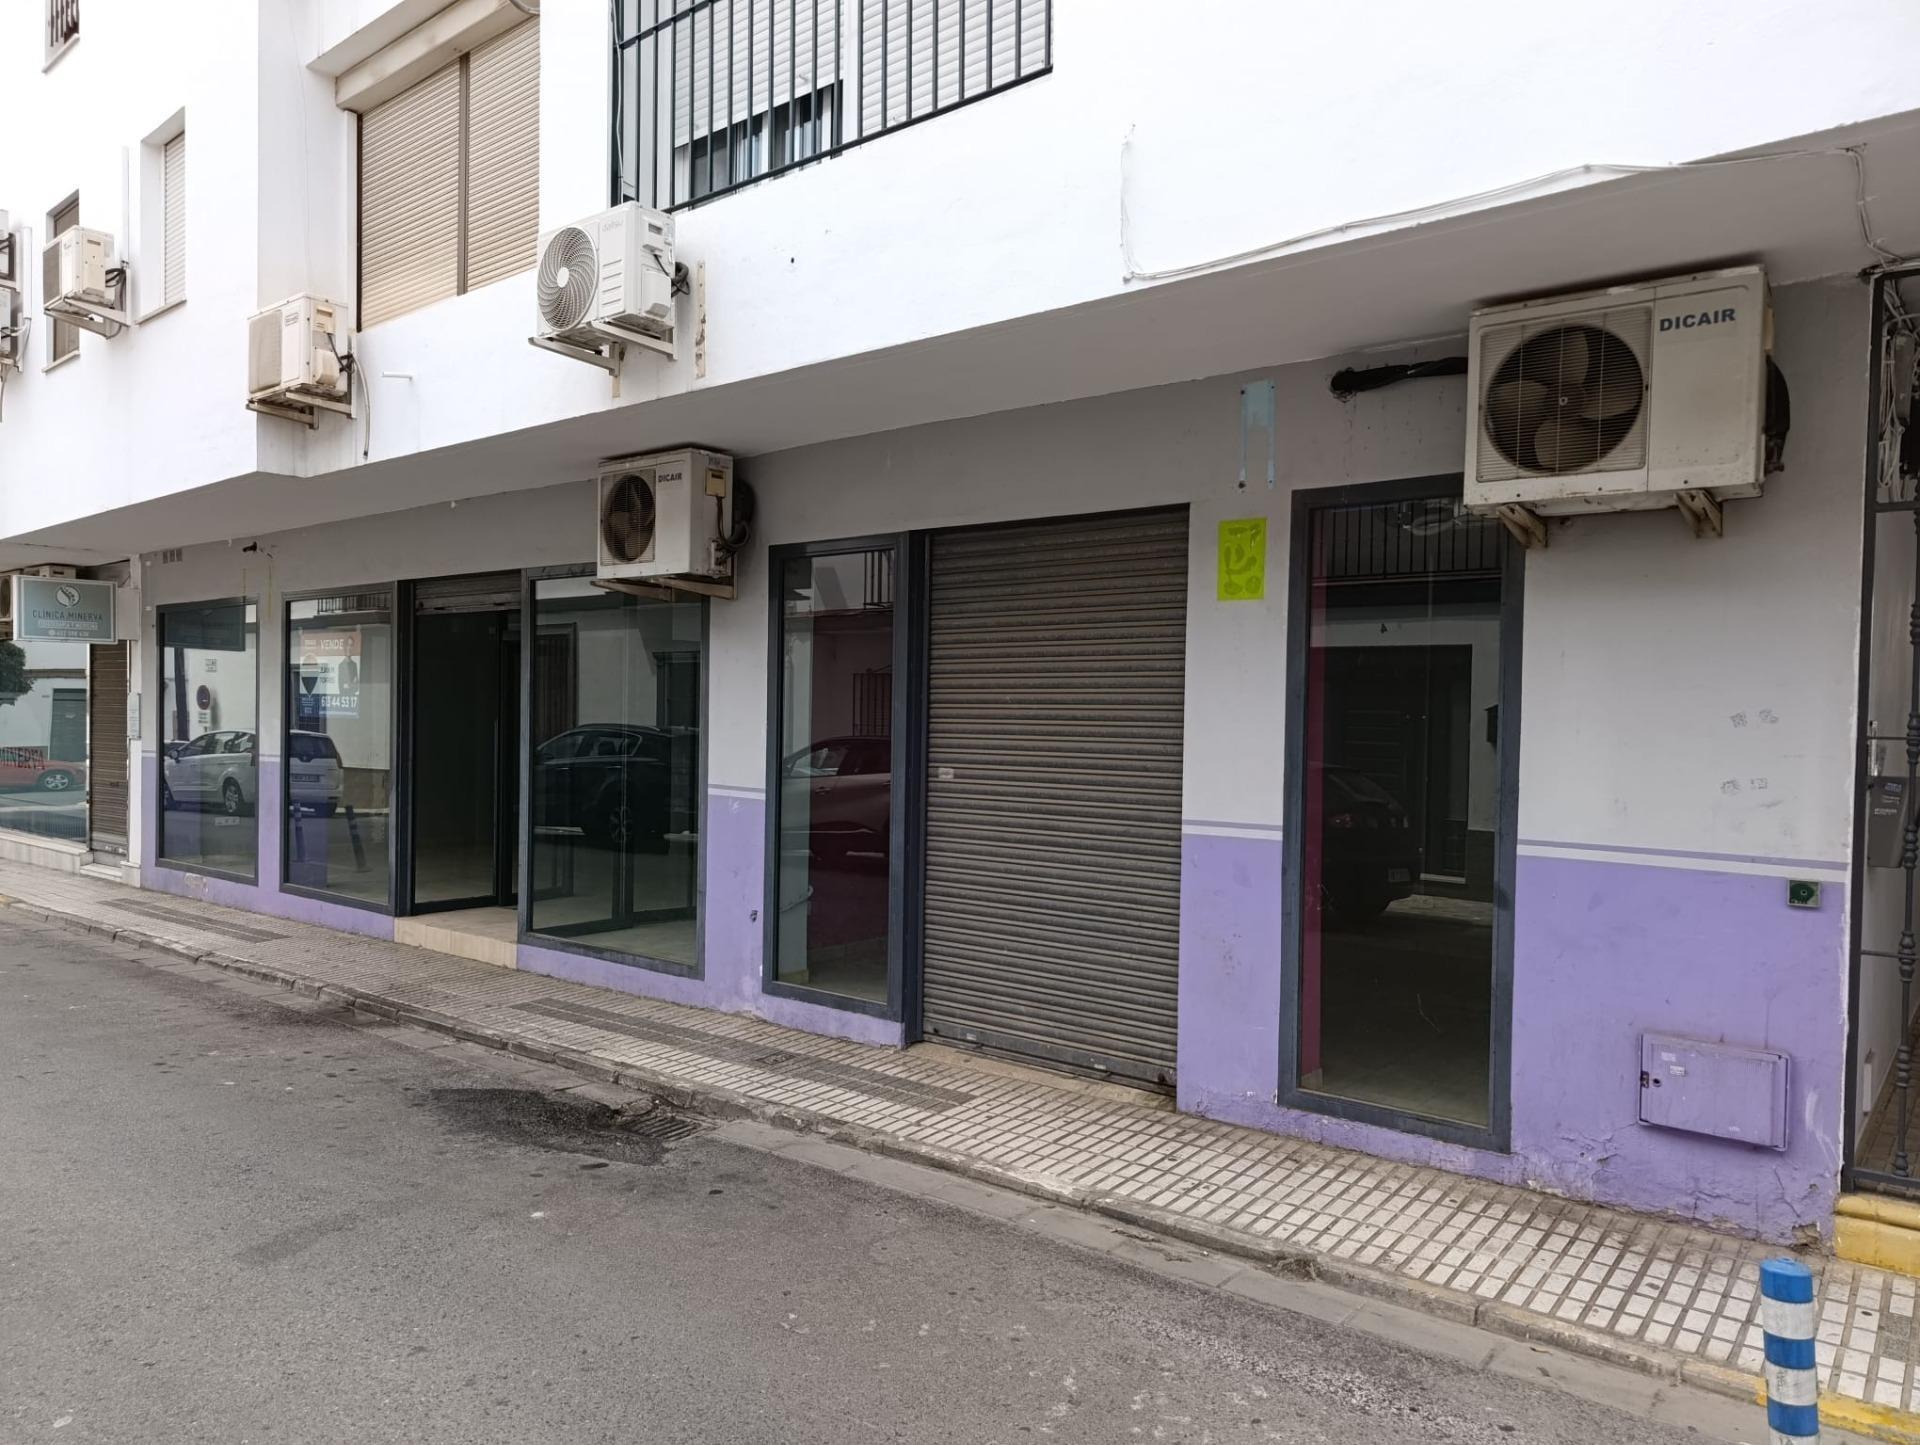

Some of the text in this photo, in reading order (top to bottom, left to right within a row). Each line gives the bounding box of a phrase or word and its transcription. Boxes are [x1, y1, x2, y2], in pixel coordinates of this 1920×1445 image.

[1659, 308, 1736, 332] DICAIR
[658, 472, 682, 483] DICAIR
[68, 611, 103, 622] MINERVA
[320, 639, 345, 650] VENDE
